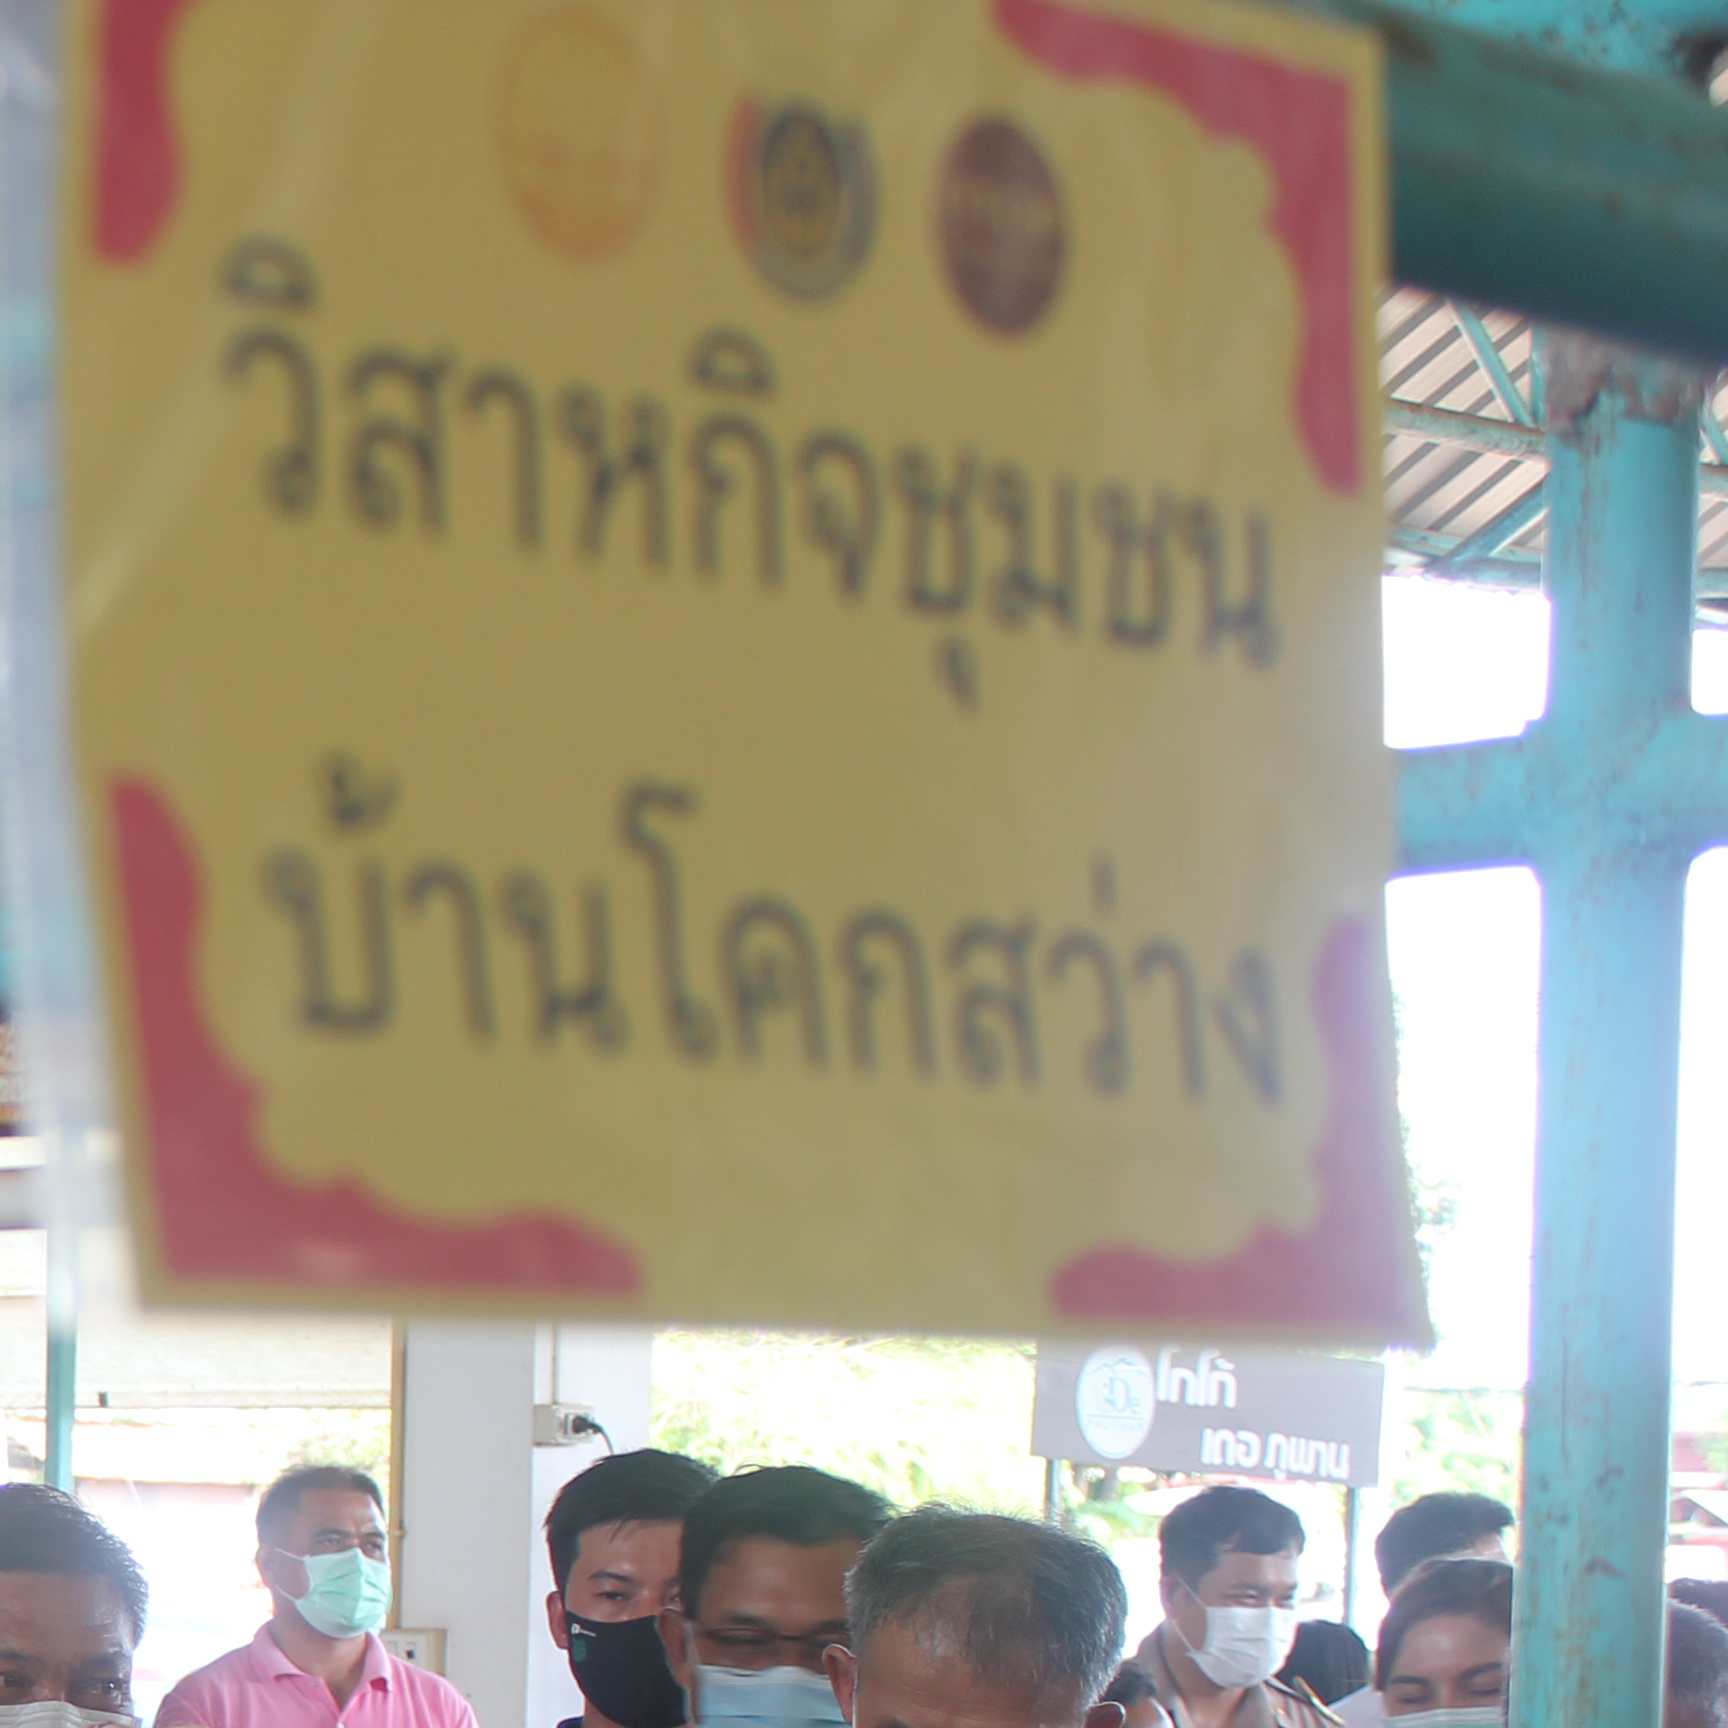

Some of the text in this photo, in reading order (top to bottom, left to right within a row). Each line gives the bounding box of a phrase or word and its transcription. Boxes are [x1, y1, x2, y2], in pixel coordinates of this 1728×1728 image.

[219, 238, 1282, 708] วิสาหกิจชุมชน
[260, 755, 1286, 1106] บ้านโคกสว่าง
[1263, 1432, 1352, 1481] ภูพาน
